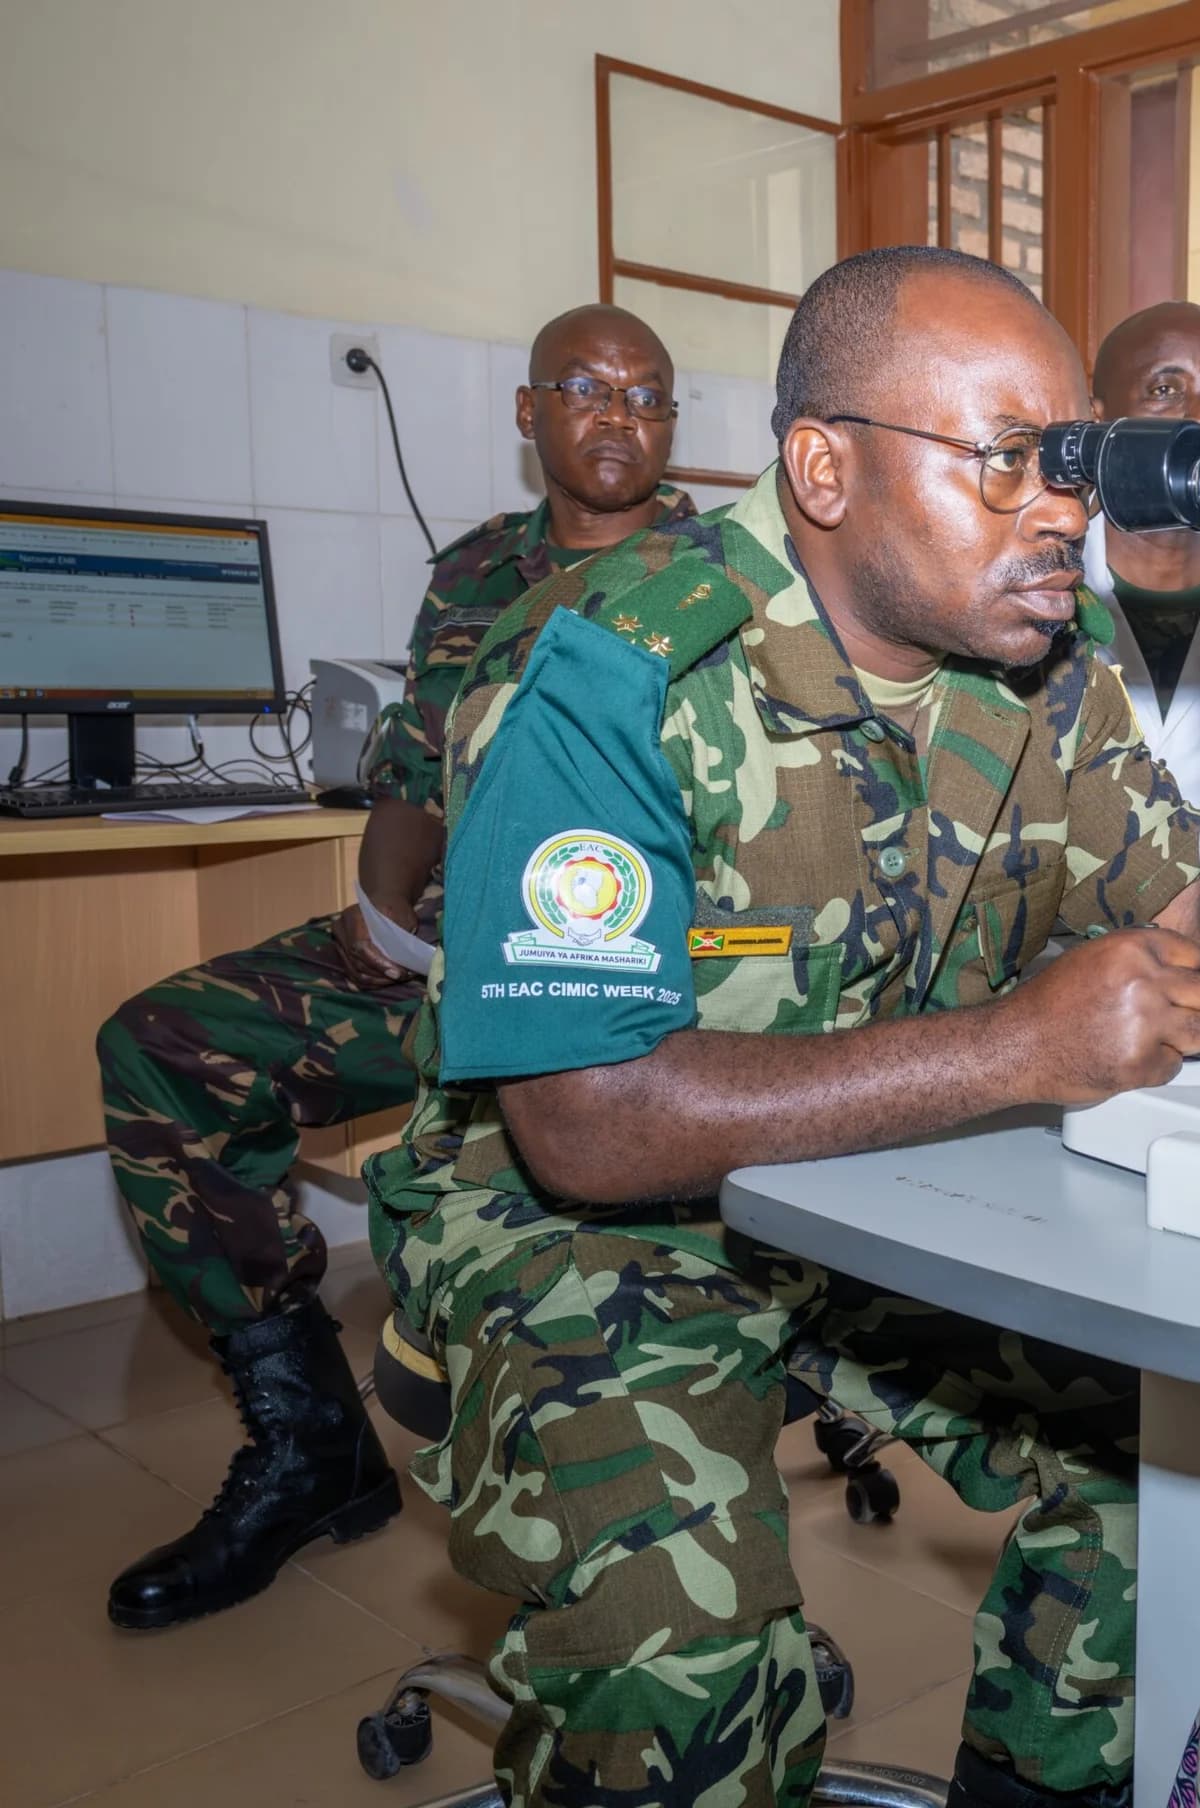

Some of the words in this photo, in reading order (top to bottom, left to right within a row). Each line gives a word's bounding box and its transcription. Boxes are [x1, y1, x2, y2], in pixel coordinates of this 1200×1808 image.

[519, 949, 556, 959] JUMUIYA
[558, 951, 568, 959] YA
[570, 952, 600, 962] AFRIKA
[601, 955, 647, 966] MASHARIKI
[481, 984, 505, 999] 5TH
[508, 982, 543, 997] EAC
[548, 982, 599, 997] CIMIC
[603, 984, 655, 1000] WEEK
[656, 988, 682, 1006] 2025
